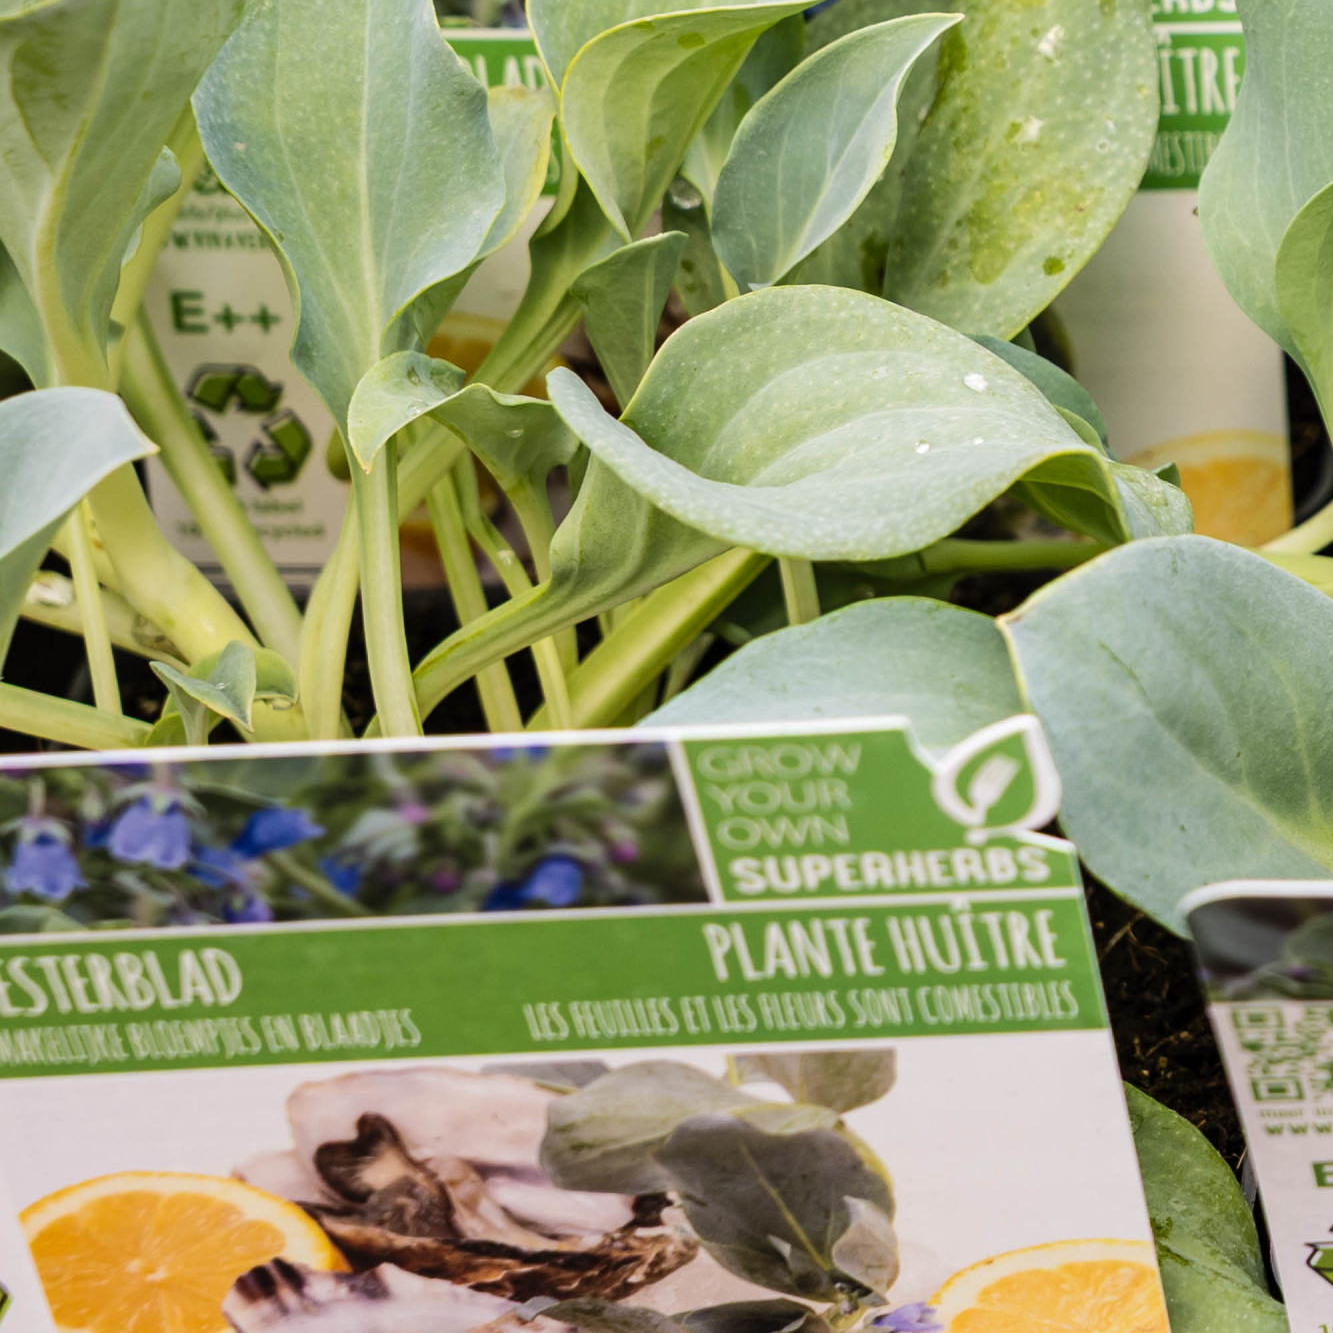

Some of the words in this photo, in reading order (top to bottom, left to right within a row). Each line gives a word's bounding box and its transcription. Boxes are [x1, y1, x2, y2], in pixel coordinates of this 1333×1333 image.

[170, 290, 281, 335] E++
[698, 743, 862, 781] GROW
[706, 778, 853, 815] YOUR
[717, 816, 850, 848] OWN
[729, 846, 1052, 895] SUPERHERBS
[703, 917, 885, 982] PLANTE
[887, 897, 1067, 974] HUÎTRE
[0, 948, 243, 1017] ESTERBLAD
[125, 1017, 261, 1059] BLOEMPJES
[260, 1014, 300, 1053] EN
[300, 1009, 421, 1051] BLAADJES
[523, 1002, 569, 1040] LES
[571, 997, 679, 1038] FEUILLES
[684, 996, 711, 1033] ET
[713, 994, 757, 1032] LES
[759, 990, 845, 1030] FLEURS
[848, 986, 914, 1027] SONT
[920, 980, 1079, 1023] COMESTIBLES
